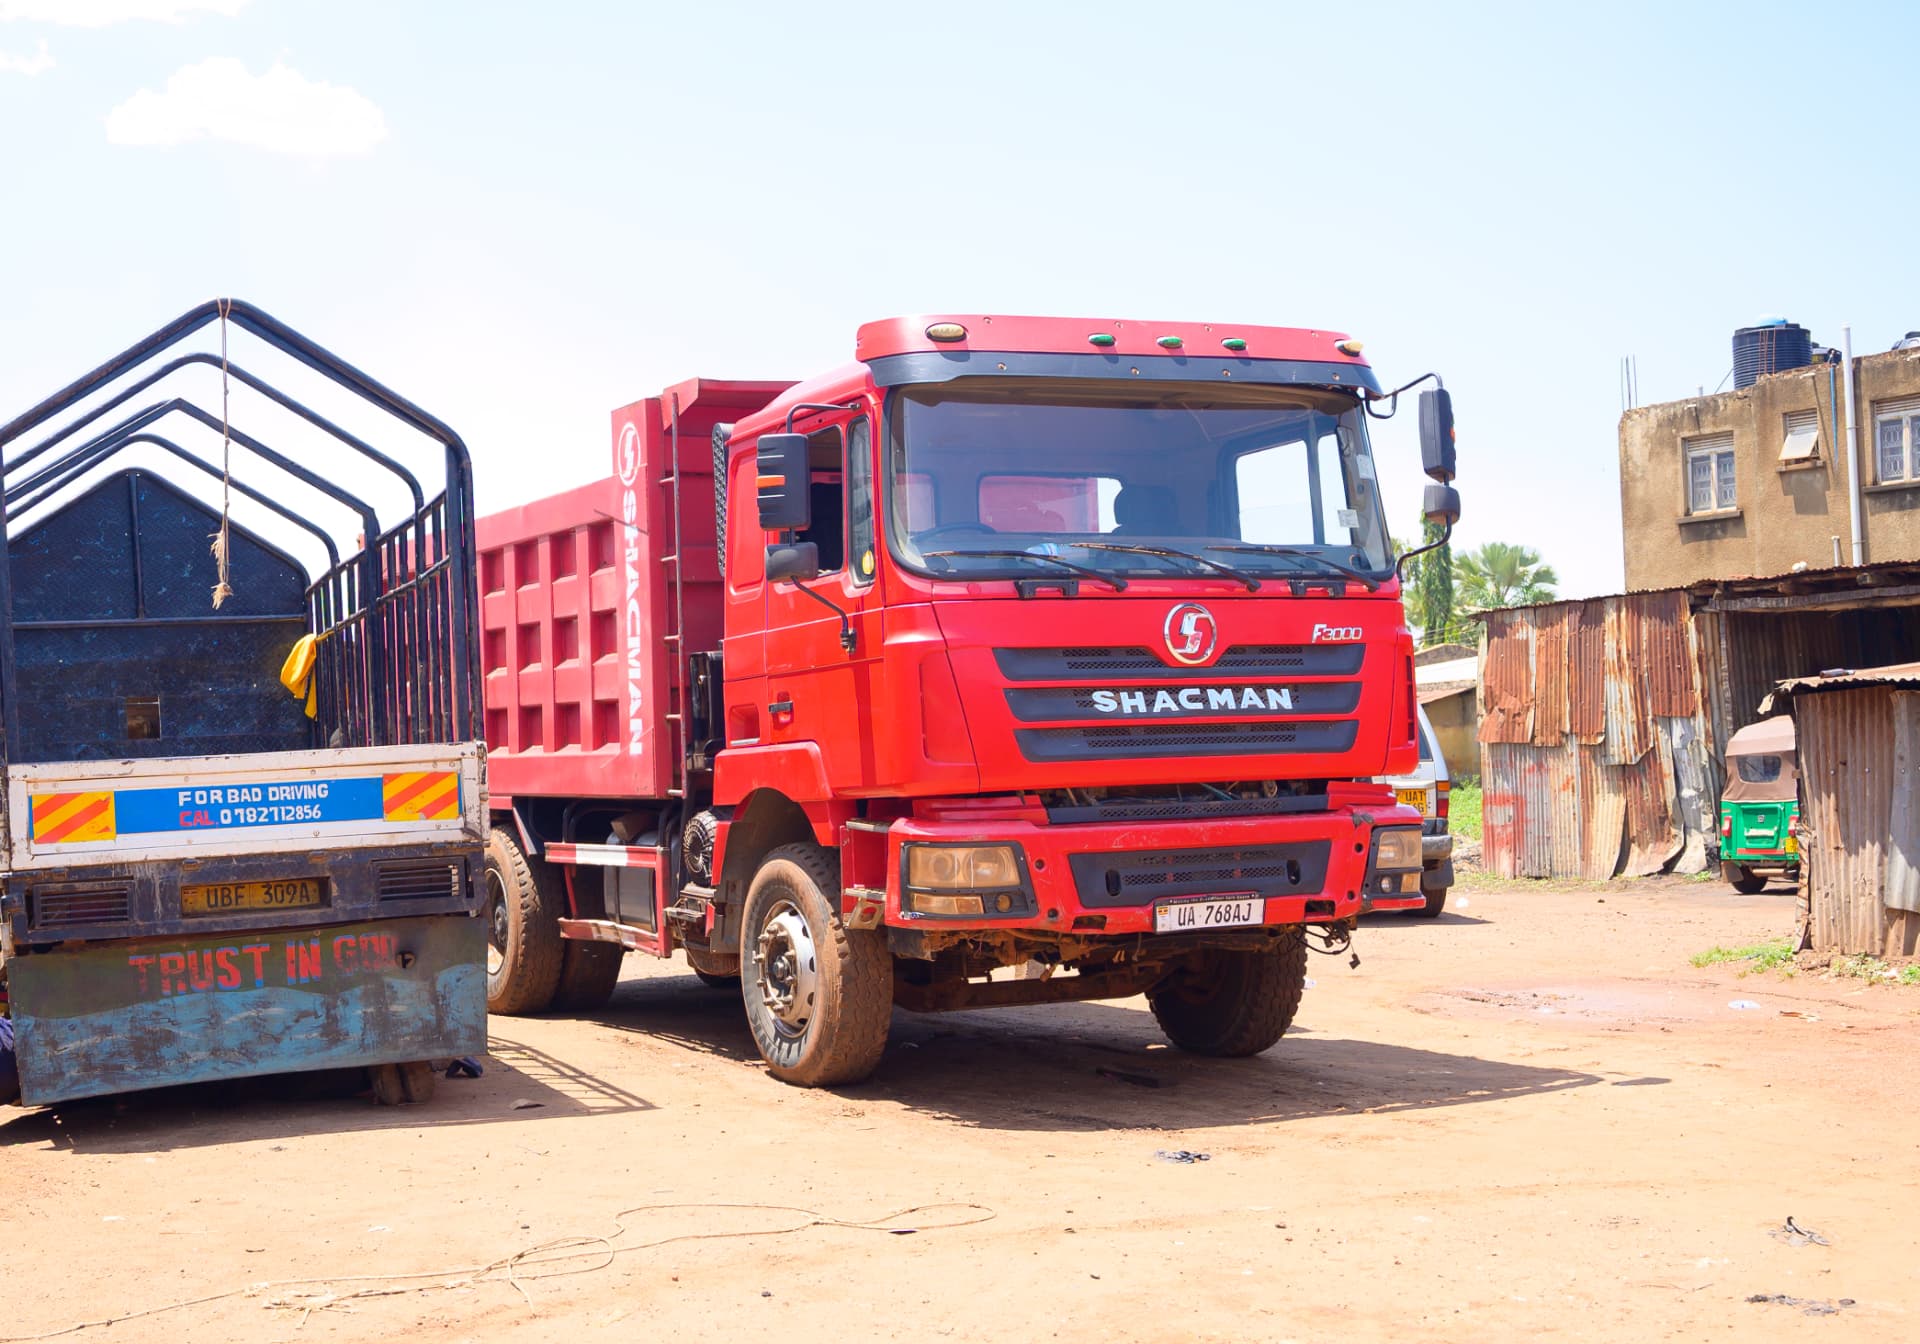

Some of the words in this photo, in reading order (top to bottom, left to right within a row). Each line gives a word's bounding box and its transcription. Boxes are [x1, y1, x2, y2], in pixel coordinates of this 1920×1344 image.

[622, 488, 644, 756] SHACMAN
[1311, 623, 1363, 644] F3000
[1091, 687, 1294, 715] SHACMAN
[178, 789, 223, 807] FOR
[227, 787, 262, 804] BAD
[268, 783, 329, 801] DRIVING
[1405, 790, 1425, 802] UAT
[220, 804, 322, 825] 0782712856
[207, 886, 246, 908] UBF
[261, 882, 311, 904] 309A
[1178, 907, 1196, 927] UA
[1204, 903, 1252, 925] 768AJ
[128, 943, 270, 996] TRUST
[286, 938, 322, 986] IN
